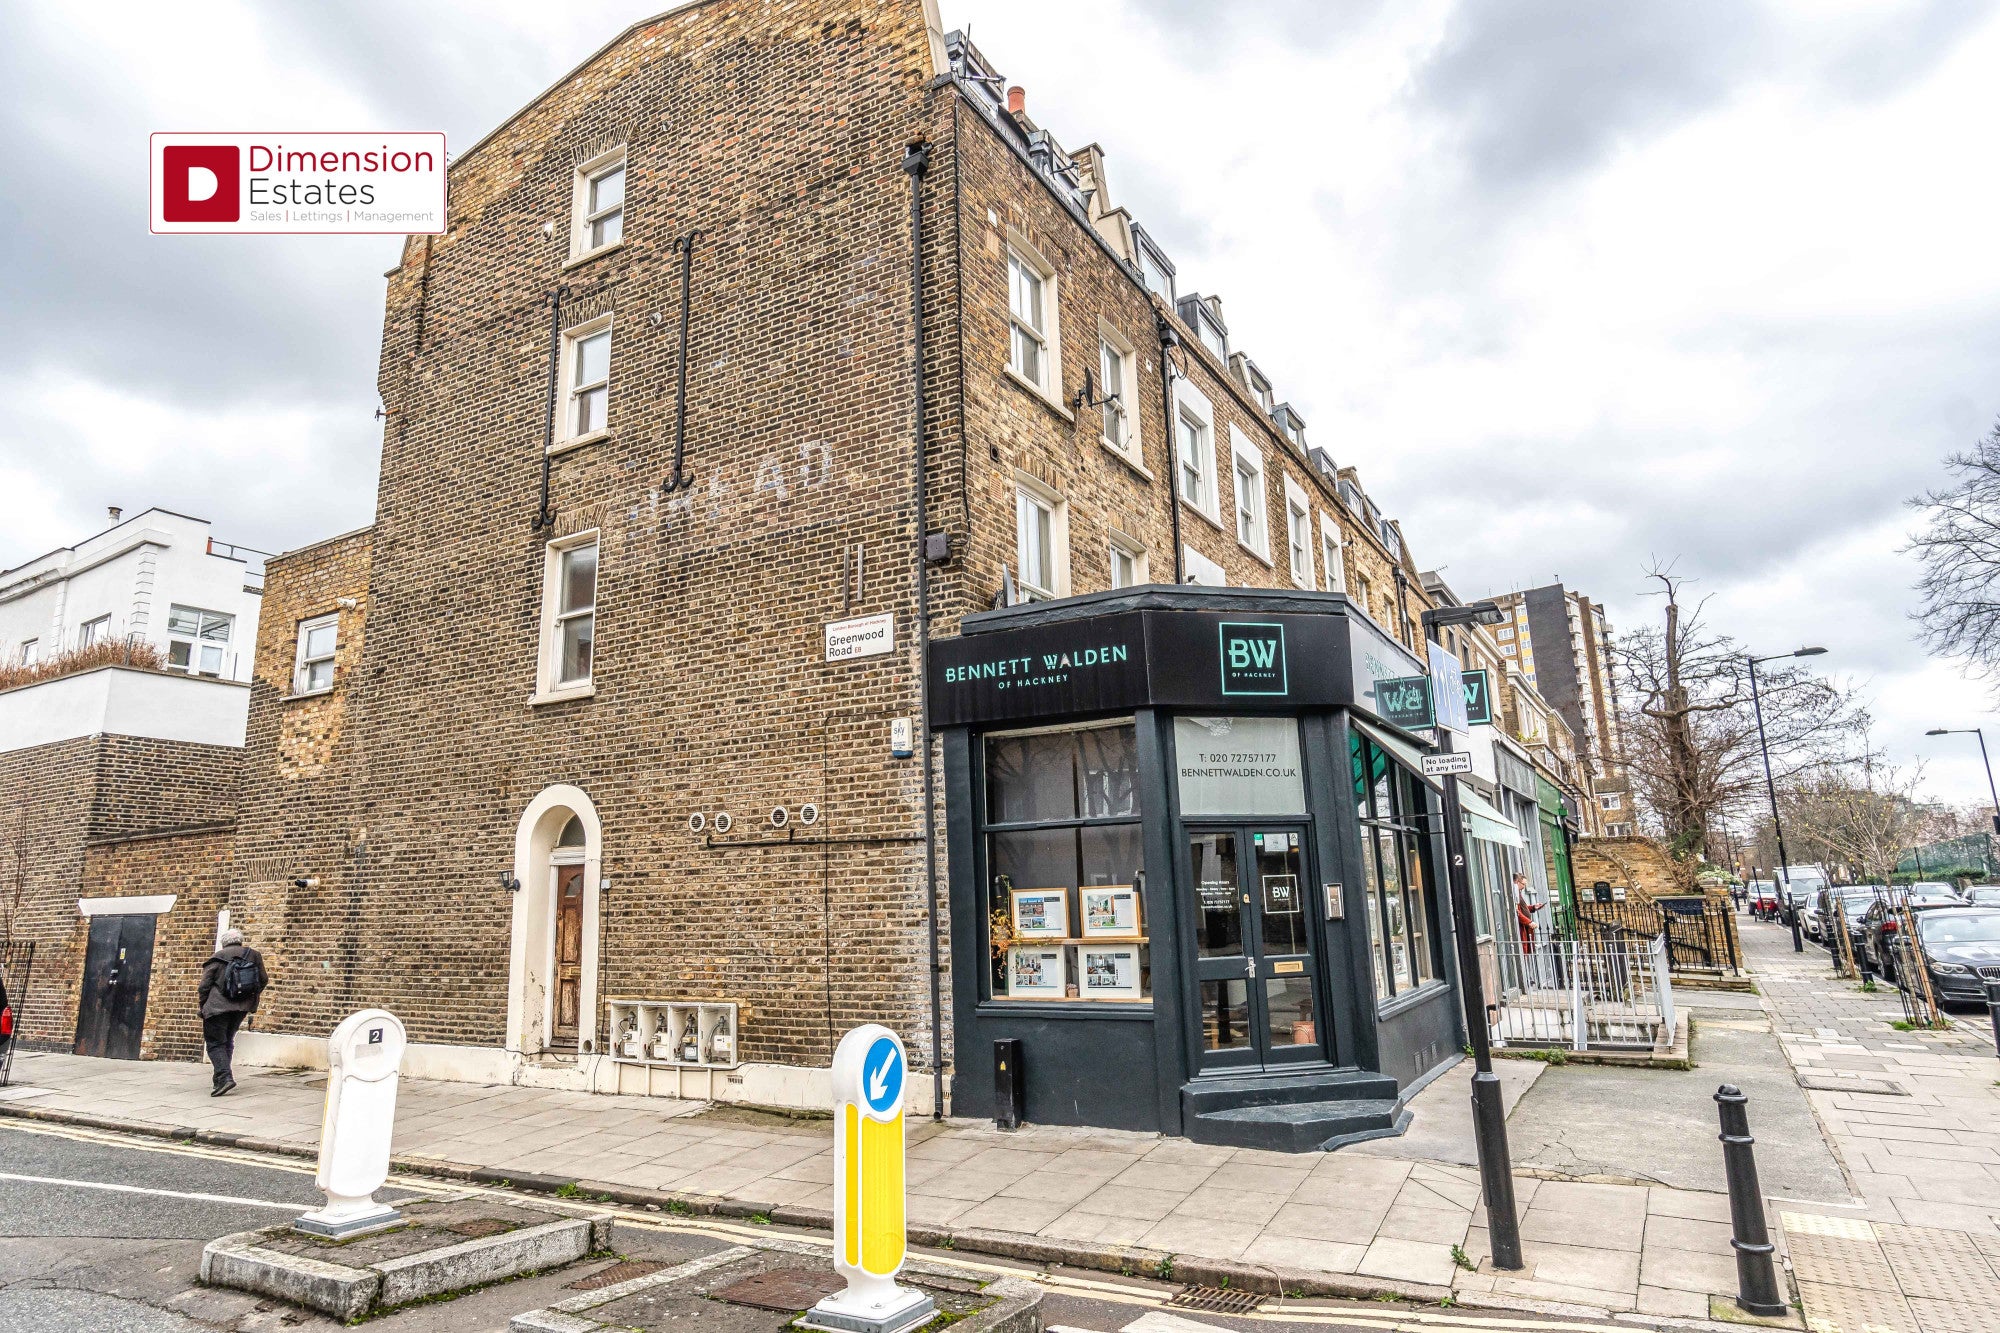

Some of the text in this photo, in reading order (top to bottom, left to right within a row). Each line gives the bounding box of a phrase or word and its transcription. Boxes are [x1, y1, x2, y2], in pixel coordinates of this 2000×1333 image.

[829, 628, 884, 646] Greenwood
[829, 645, 852, 657] Road
[1228, 639, 1277, 668] BW
[945, 645, 1128, 682] BENNETT WALDEN
[998, 674, 1069, 689] OF HACKNEY
[1199, 754, 1276, 762] T: 020 72757177
[1181, 768, 1296, 777] BENNETTWALDEN.CO.UK
[1454, 855, 1463, 865] 2
[1272, 887, 1289, 898] BW
[372, 1031, 380, 1041] 2
